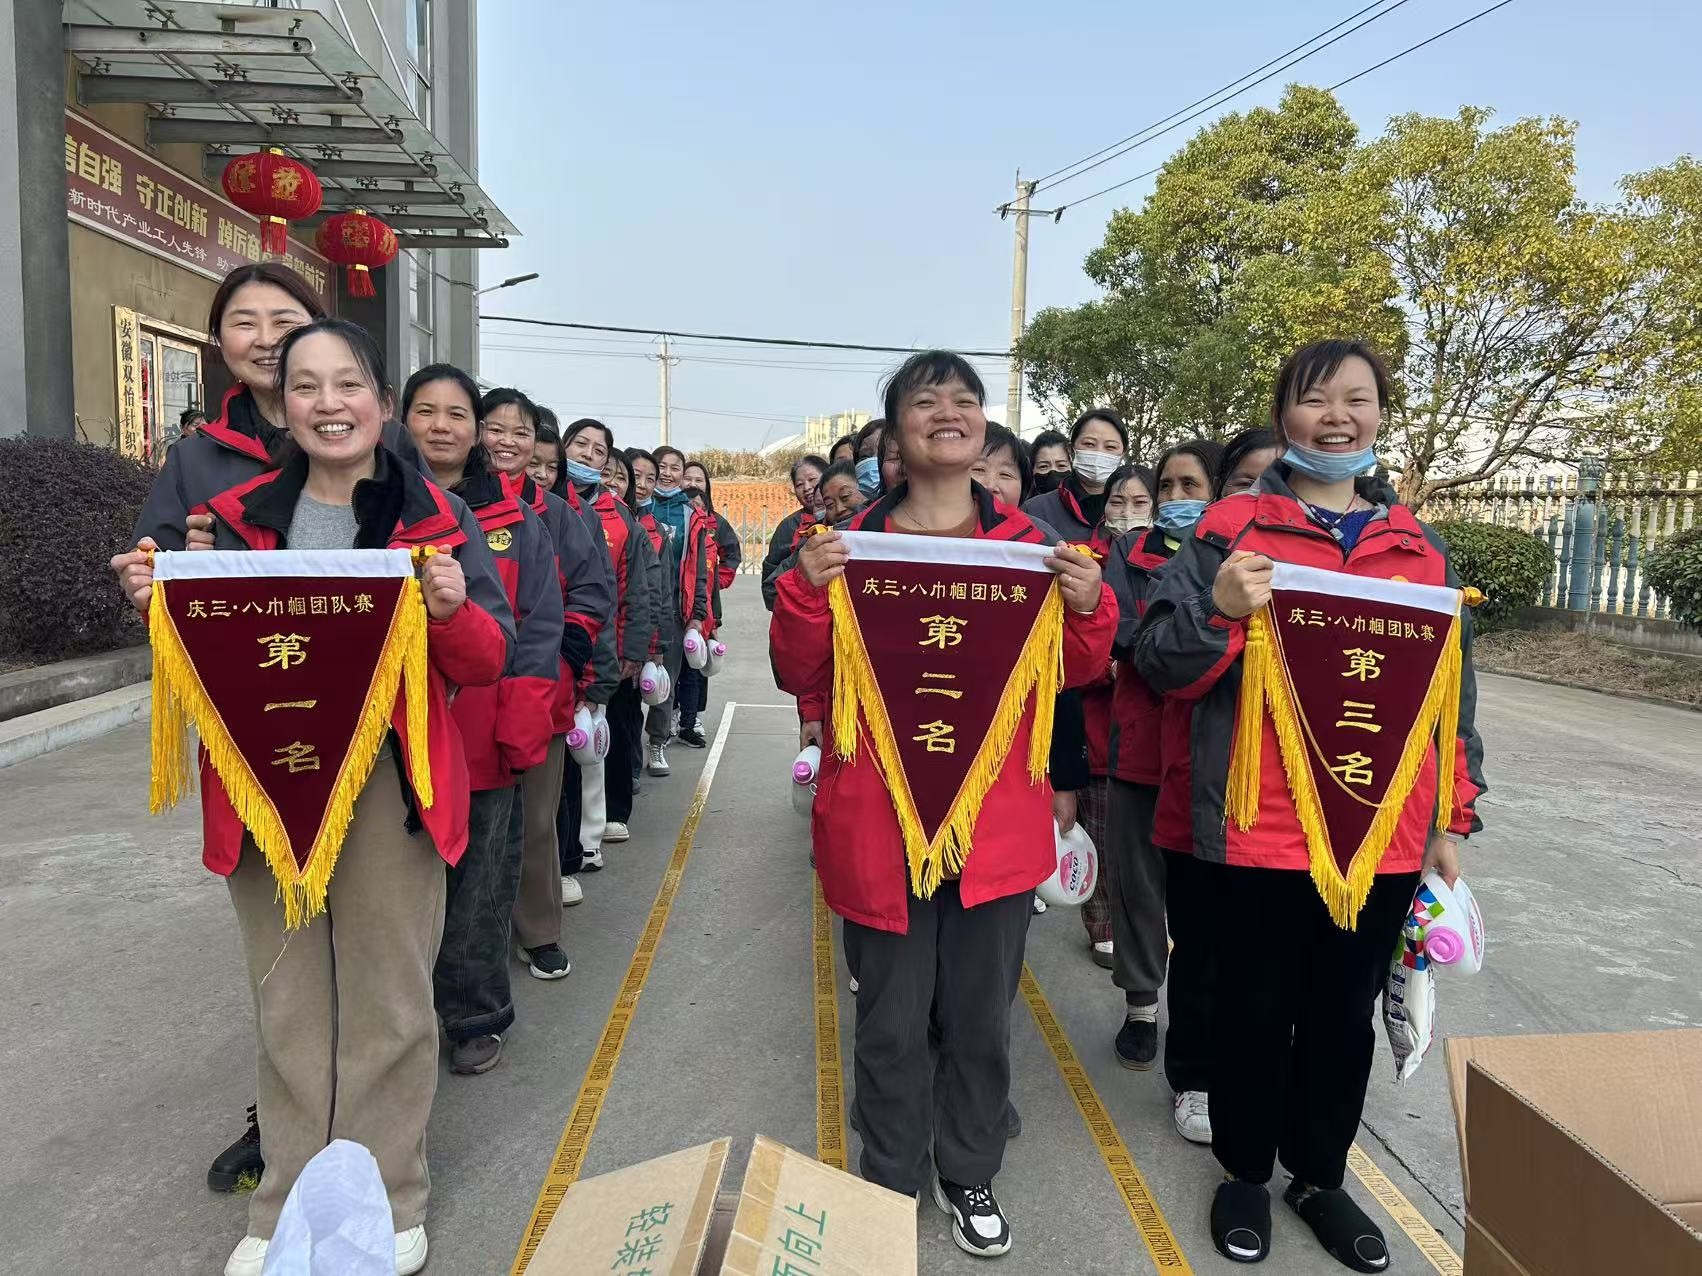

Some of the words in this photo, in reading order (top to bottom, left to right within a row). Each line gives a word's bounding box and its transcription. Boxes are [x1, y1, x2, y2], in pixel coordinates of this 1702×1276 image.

[68, 188, 207, 262] 新时代产业工人先锋
[136, 173, 208, 238] 守正创新
[120, 318, 138, 461] 安徽双怡针织
[186, 593, 375, 618] 庆三·八巾帼团队赛
[862, 577, 1028, 603] 庆三·八巾帼团队赛
[1287, 607, 1436, 643] 庆三·八巾帼团队赛
[257, 632, 320, 773] 第一名
[912, 614, 968, 754] 第二名
[1330, 647, 1385, 786] 第三名
[611, 1202, 674, 1276] 轻装
